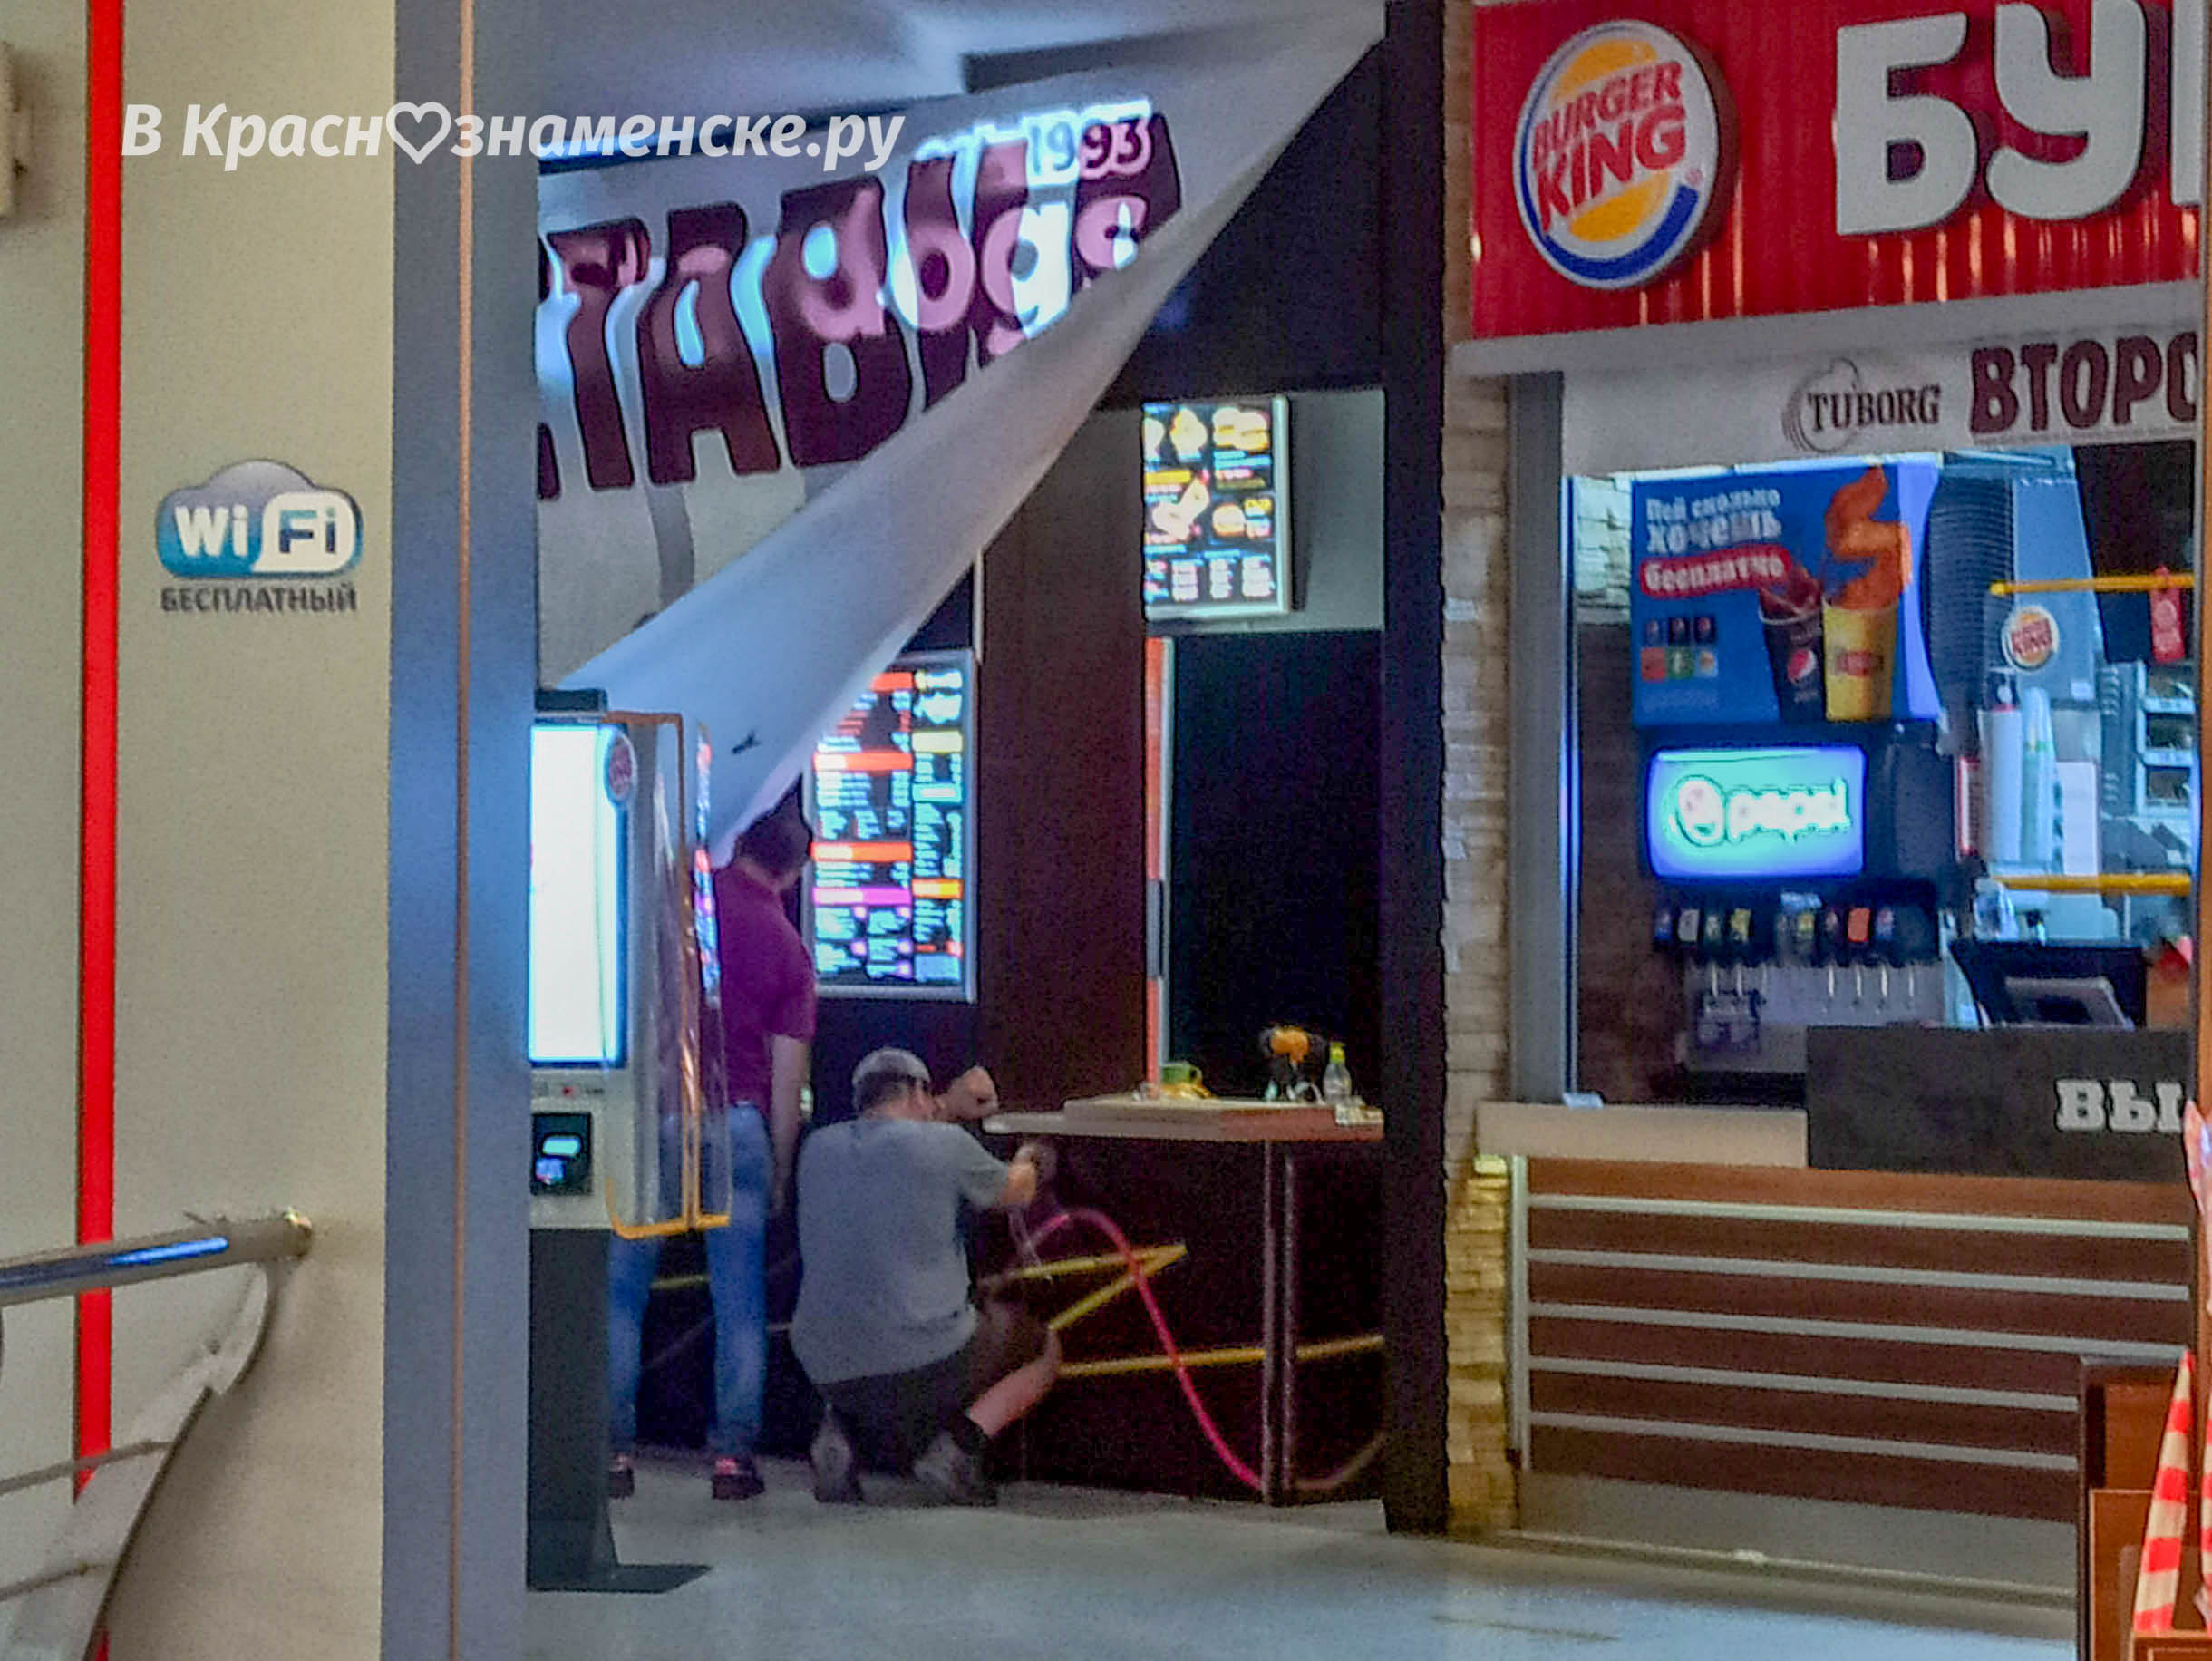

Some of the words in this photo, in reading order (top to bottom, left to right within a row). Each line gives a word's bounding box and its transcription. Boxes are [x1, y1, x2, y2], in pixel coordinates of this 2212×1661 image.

[1532, 61, 1683, 170] BURGER
[1538, 103, 1686, 233] KING
[1808, 384, 1941, 431] TUBORG
[161, 581, 359, 614] БЕСПЛАТНЫЙ
